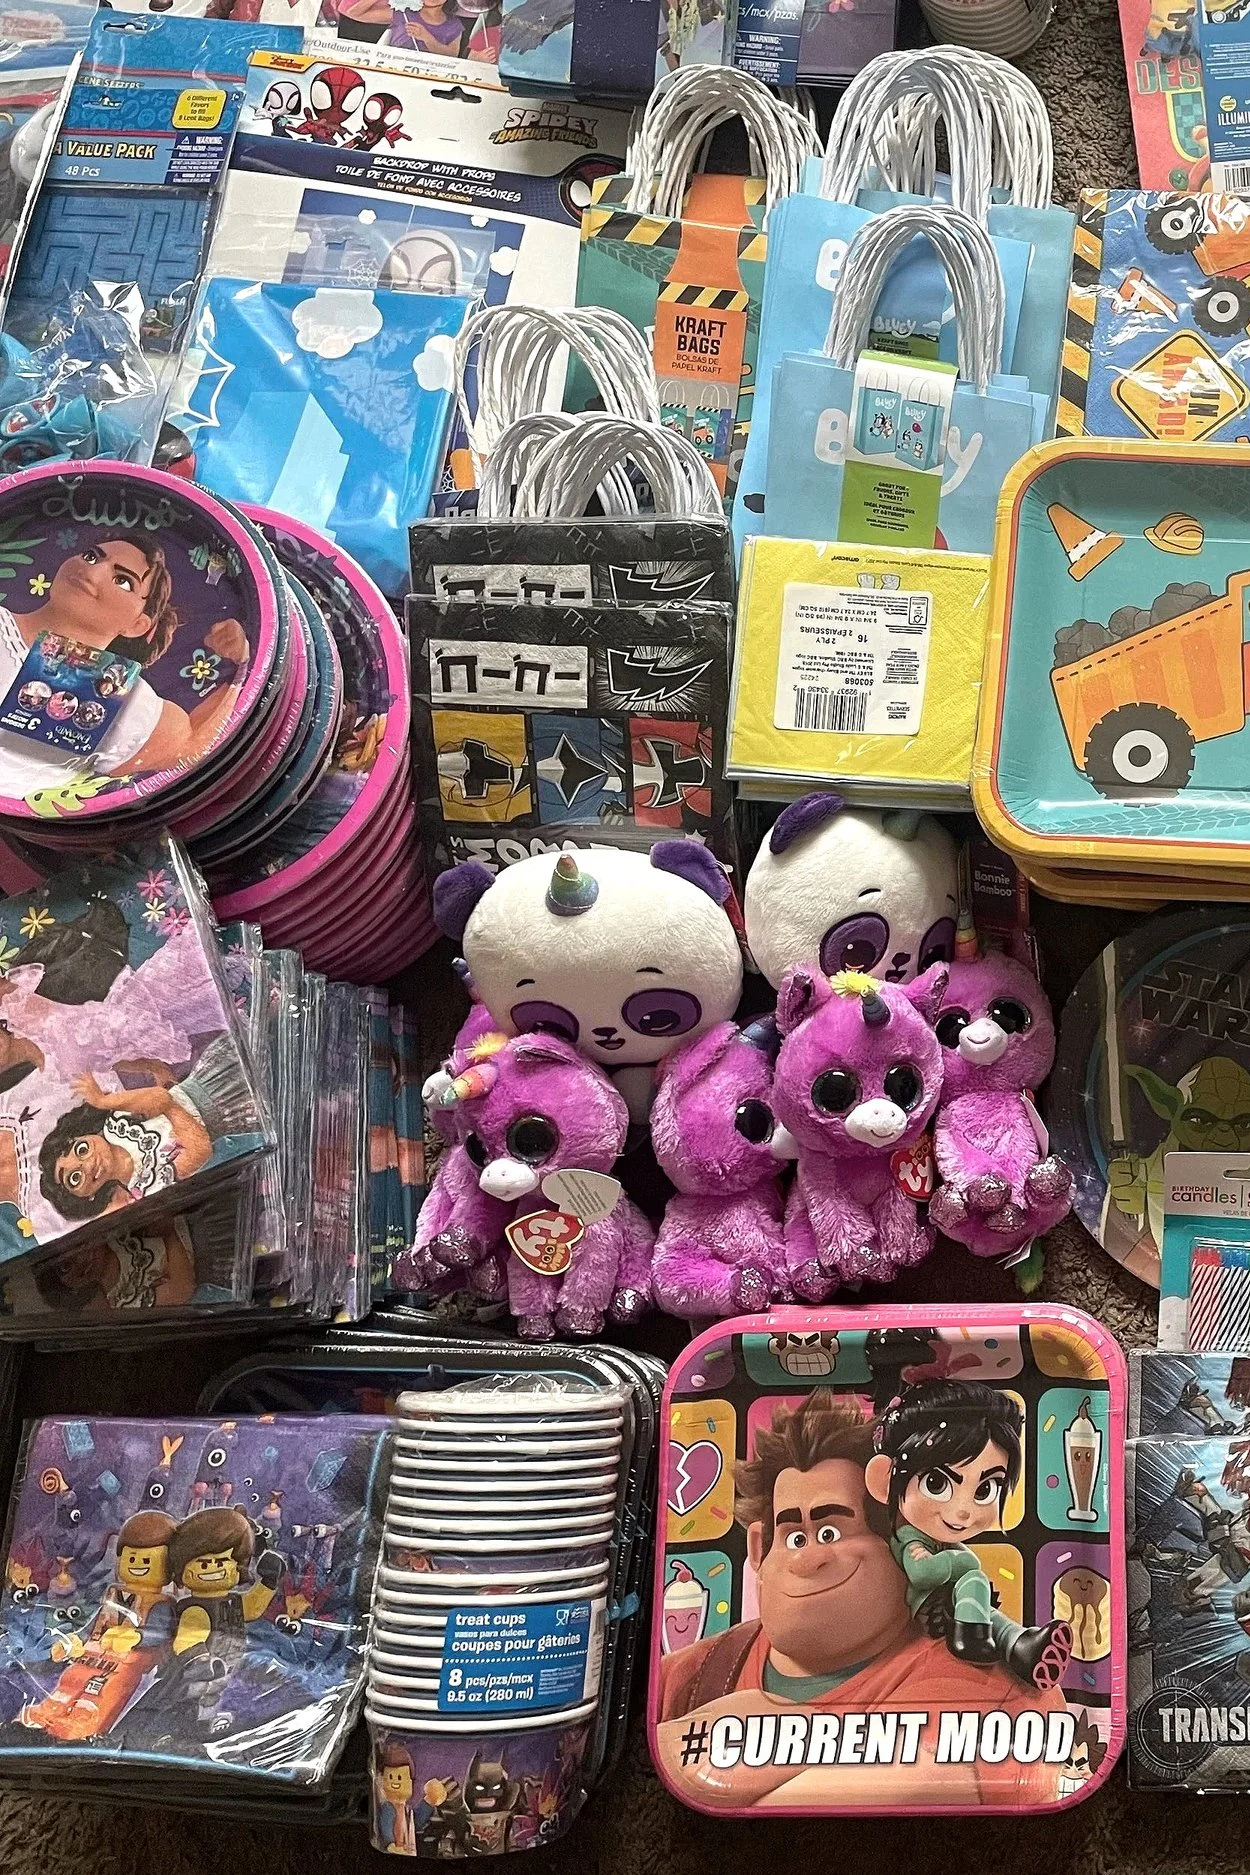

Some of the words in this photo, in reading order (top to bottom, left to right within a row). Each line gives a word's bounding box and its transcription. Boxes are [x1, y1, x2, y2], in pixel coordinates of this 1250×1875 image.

[504, 108, 599, 135] SPIDEY
[65, 165, 79, 176] 48
[374, 157, 430, 171] BACKDROP
[432, 162, 458, 175] WITH
[462, 168, 496, 181] PROPS
[335, 165, 364, 178] TOILE
[366, 168, 381, 179] DE
[384, 170, 415, 185] FOND
[417, 176, 444, 189] AVEC
[447, 182, 522, 203] ACCESSOIRES
[675, 315, 727, 338] KRAFT
[677, 335, 721, 355] BAGS
[676, 353, 707, 364] BOLSAS
[708, 357, 719, 366] DE
[671, 362, 696, 372] PAPEL
[696, 364, 722, 375] KRAFT
[43, 475, 192, 531] Luisa
[800, 626, 847, 637] ÉPAISSEURS
[857, 634, 869, 643] 16
[845, 677, 874, 686] 503068
[28, 717, 42, 731] 3
[974, 869, 1011, 885] Bonnie
[899, 1155, 933, 1191] ty
[1171, 1187, 1237, 1204] candles
[513, 1217, 570, 1257] ty
[455, 1613, 491, 1626] treat
[493, 1613, 526, 1628] cups
[452, 1640, 502, 1654] coupes
[504, 1639, 535, 1653] pour
[537, 1632, 581, 1653] gâteries
[479, 1631, 499, 1640] para
[500, 1629, 527, 1637] dulces
[448, 1668, 463, 1687] 8
[465, 1672, 534, 1689] pcs/pzs/mcx
[447, 1690, 466, 1702] 9.5
[468, 1692, 482, 1701] oz
[485, 1689, 513, 1703] (280
[515, 1687, 534, 1701] ml)
[680, 1711, 929, 1769] #CURRENT
[932, 1710, 1077, 1765] MOOD
